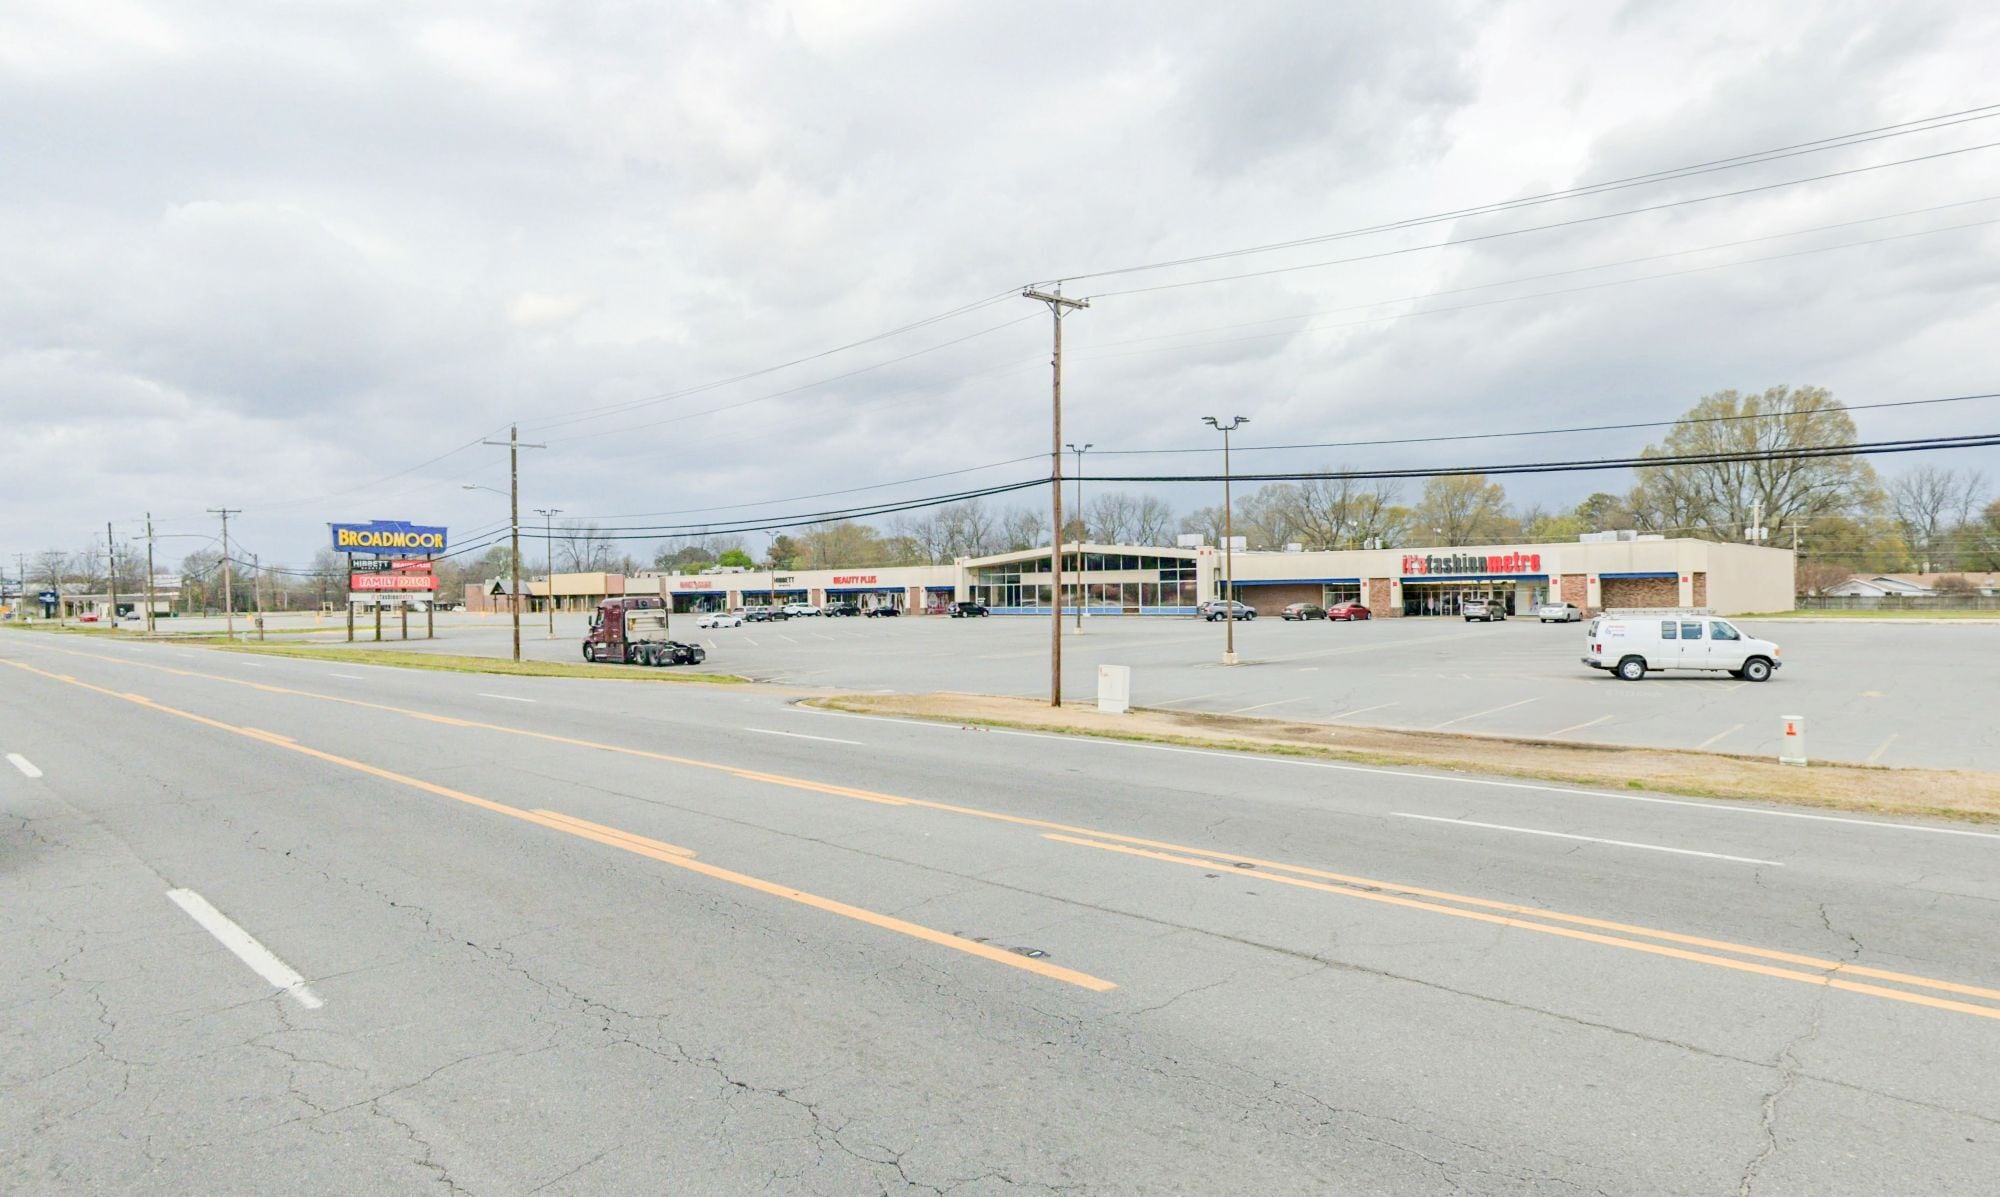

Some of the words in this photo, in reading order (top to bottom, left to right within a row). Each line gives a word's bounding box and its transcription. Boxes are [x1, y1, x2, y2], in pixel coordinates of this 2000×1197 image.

[338, 529, 443, 548] BROADMOOR
[353, 560, 389, 568] HIBBETT
[360, 576, 395, 587] FAMILY
[833, 576, 859, 584] BEAUTY
[860, 576, 877, 584] PLUS
